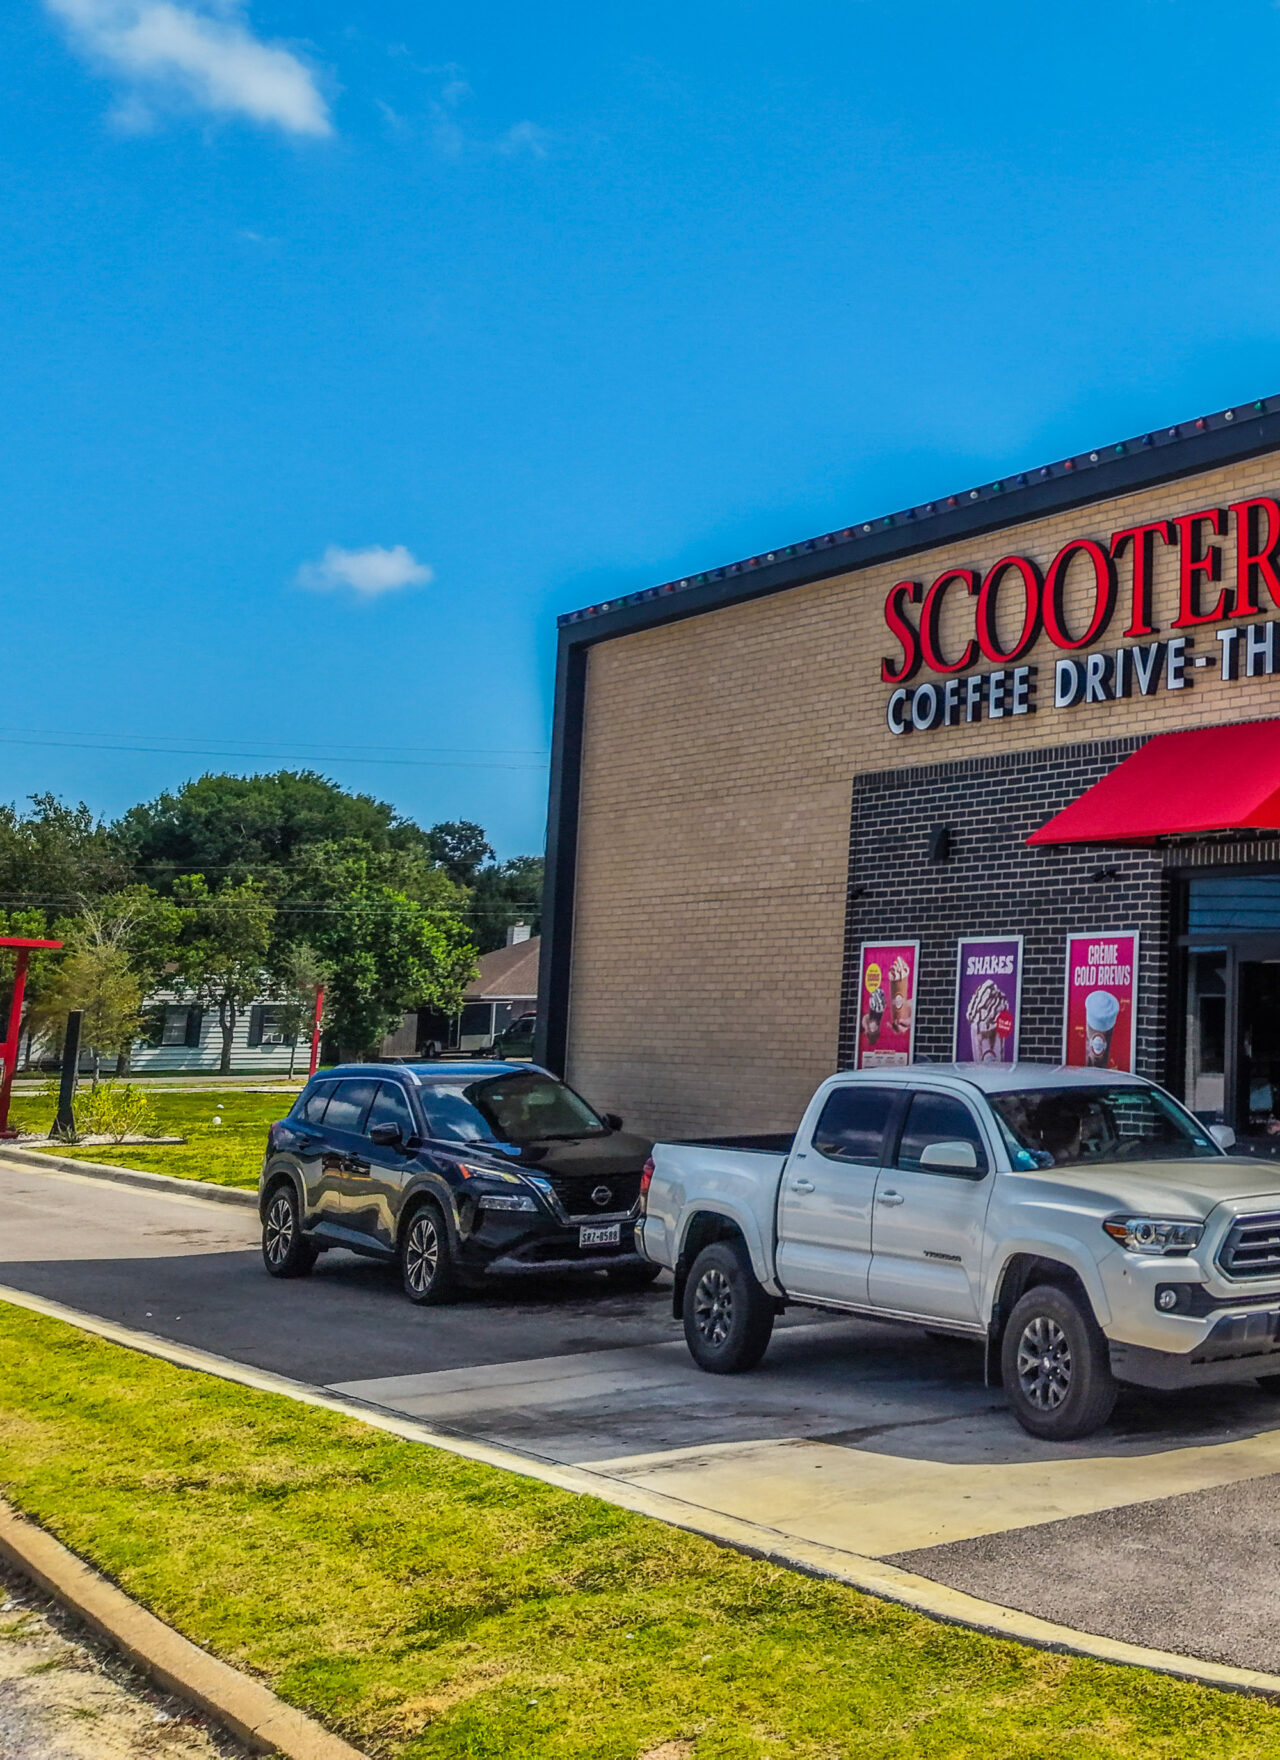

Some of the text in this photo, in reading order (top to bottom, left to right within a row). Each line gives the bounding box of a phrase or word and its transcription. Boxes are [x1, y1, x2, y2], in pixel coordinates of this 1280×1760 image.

[887, 666, 1034, 735] COFFEE
[965, 955, 1014, 976] SHAKES
[1074, 965, 1131, 986] COLD BREWS
